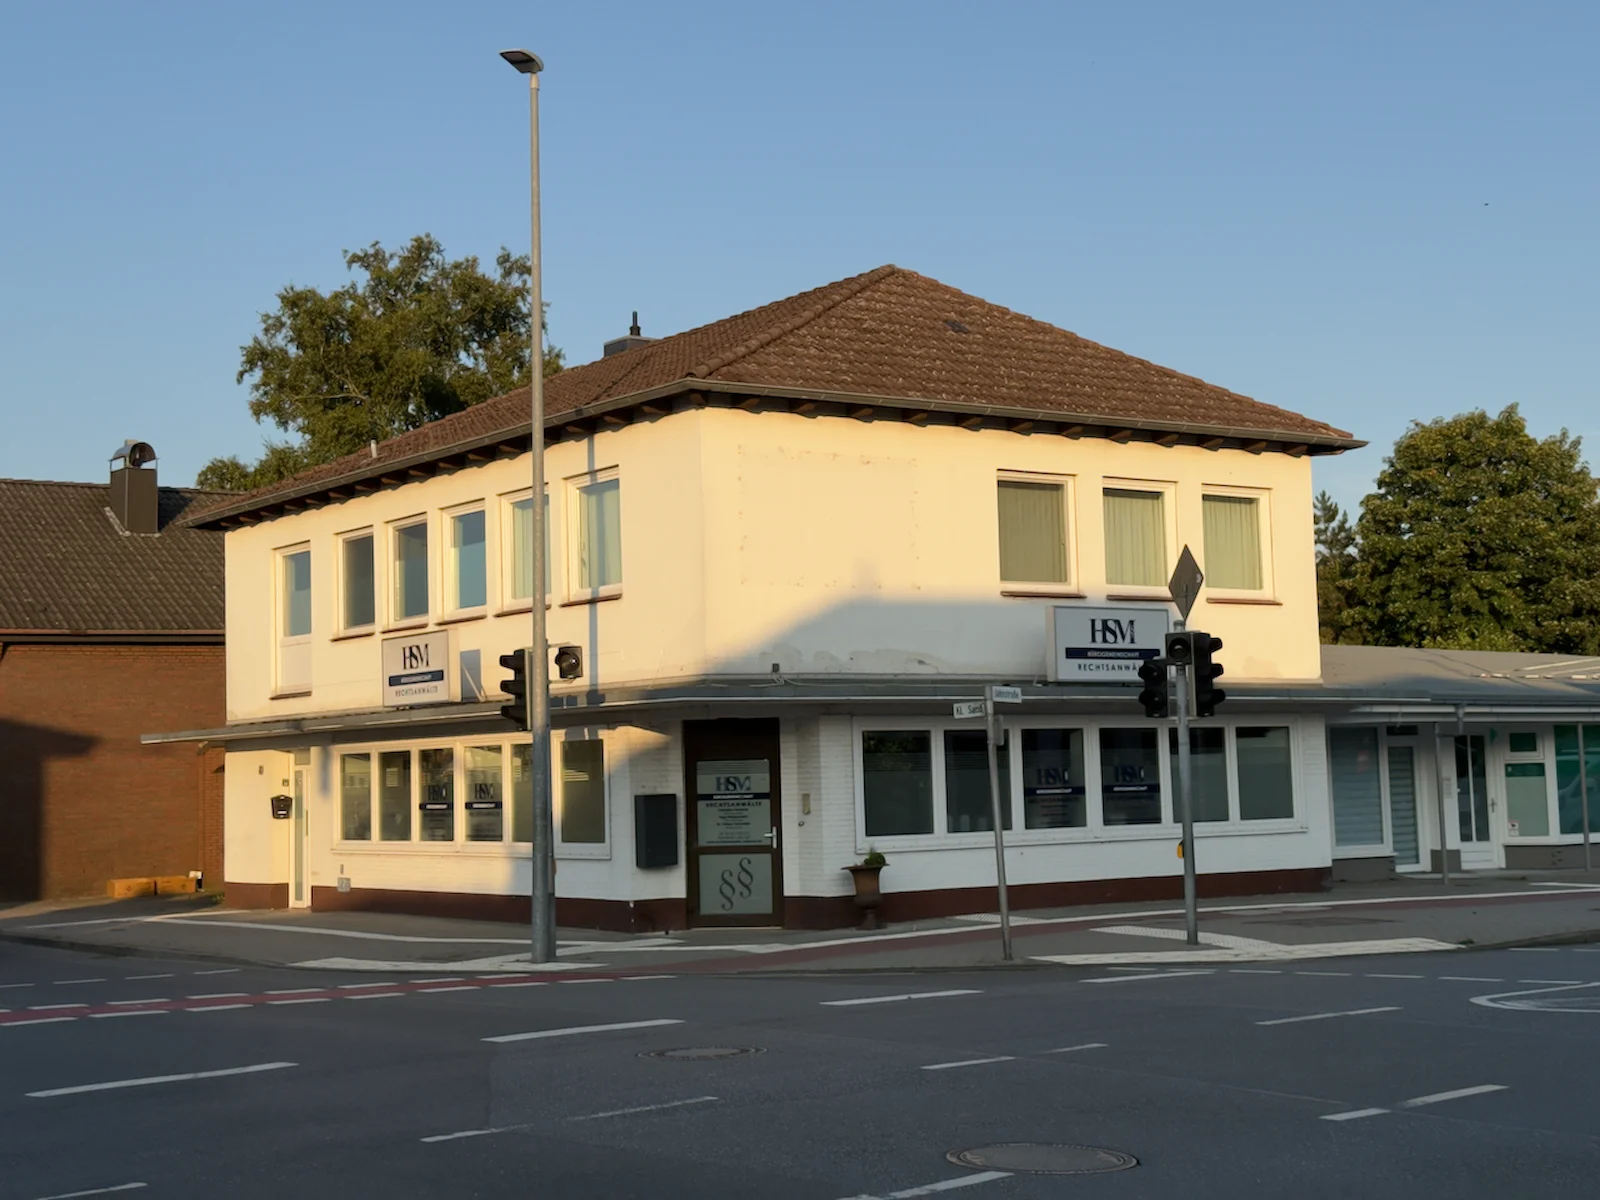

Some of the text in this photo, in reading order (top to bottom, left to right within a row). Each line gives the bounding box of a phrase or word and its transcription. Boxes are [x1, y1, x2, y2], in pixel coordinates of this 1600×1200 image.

[1089, 618, 1136, 644] HSM
[402, 643, 429, 670] HSM
[1077, 662, 1140, 672] RECHTSANWÄ
[716, 776, 751, 792] HSM
